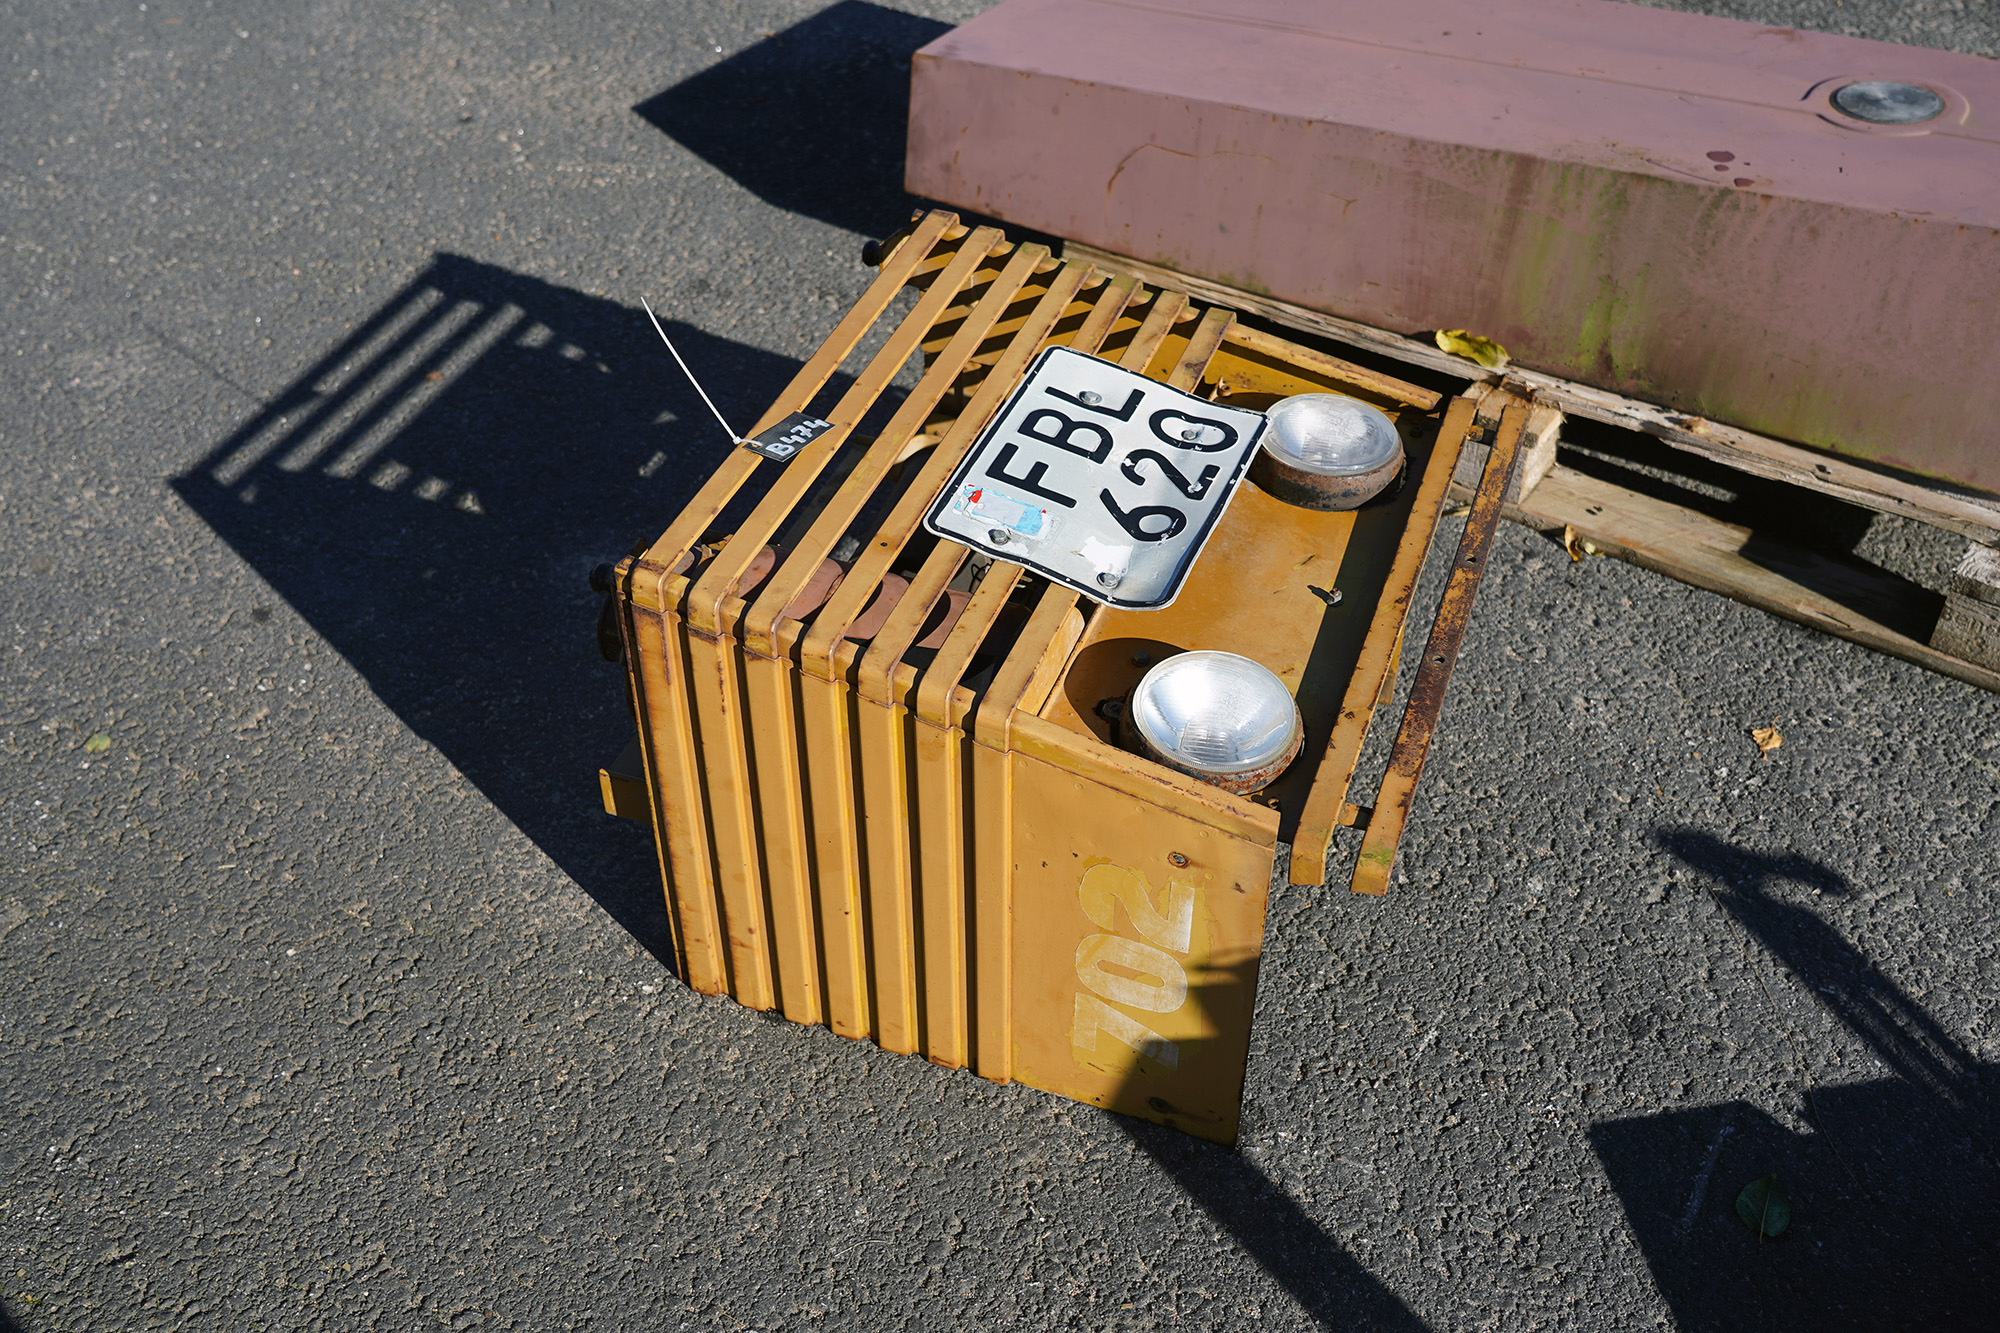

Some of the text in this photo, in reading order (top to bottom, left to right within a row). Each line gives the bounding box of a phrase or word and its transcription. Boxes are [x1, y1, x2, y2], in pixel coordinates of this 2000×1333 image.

[985, 385, 1146, 509] FBL
[1099, 408, 1240, 542] 620
[1073, 863, 1195, 1071] 702
